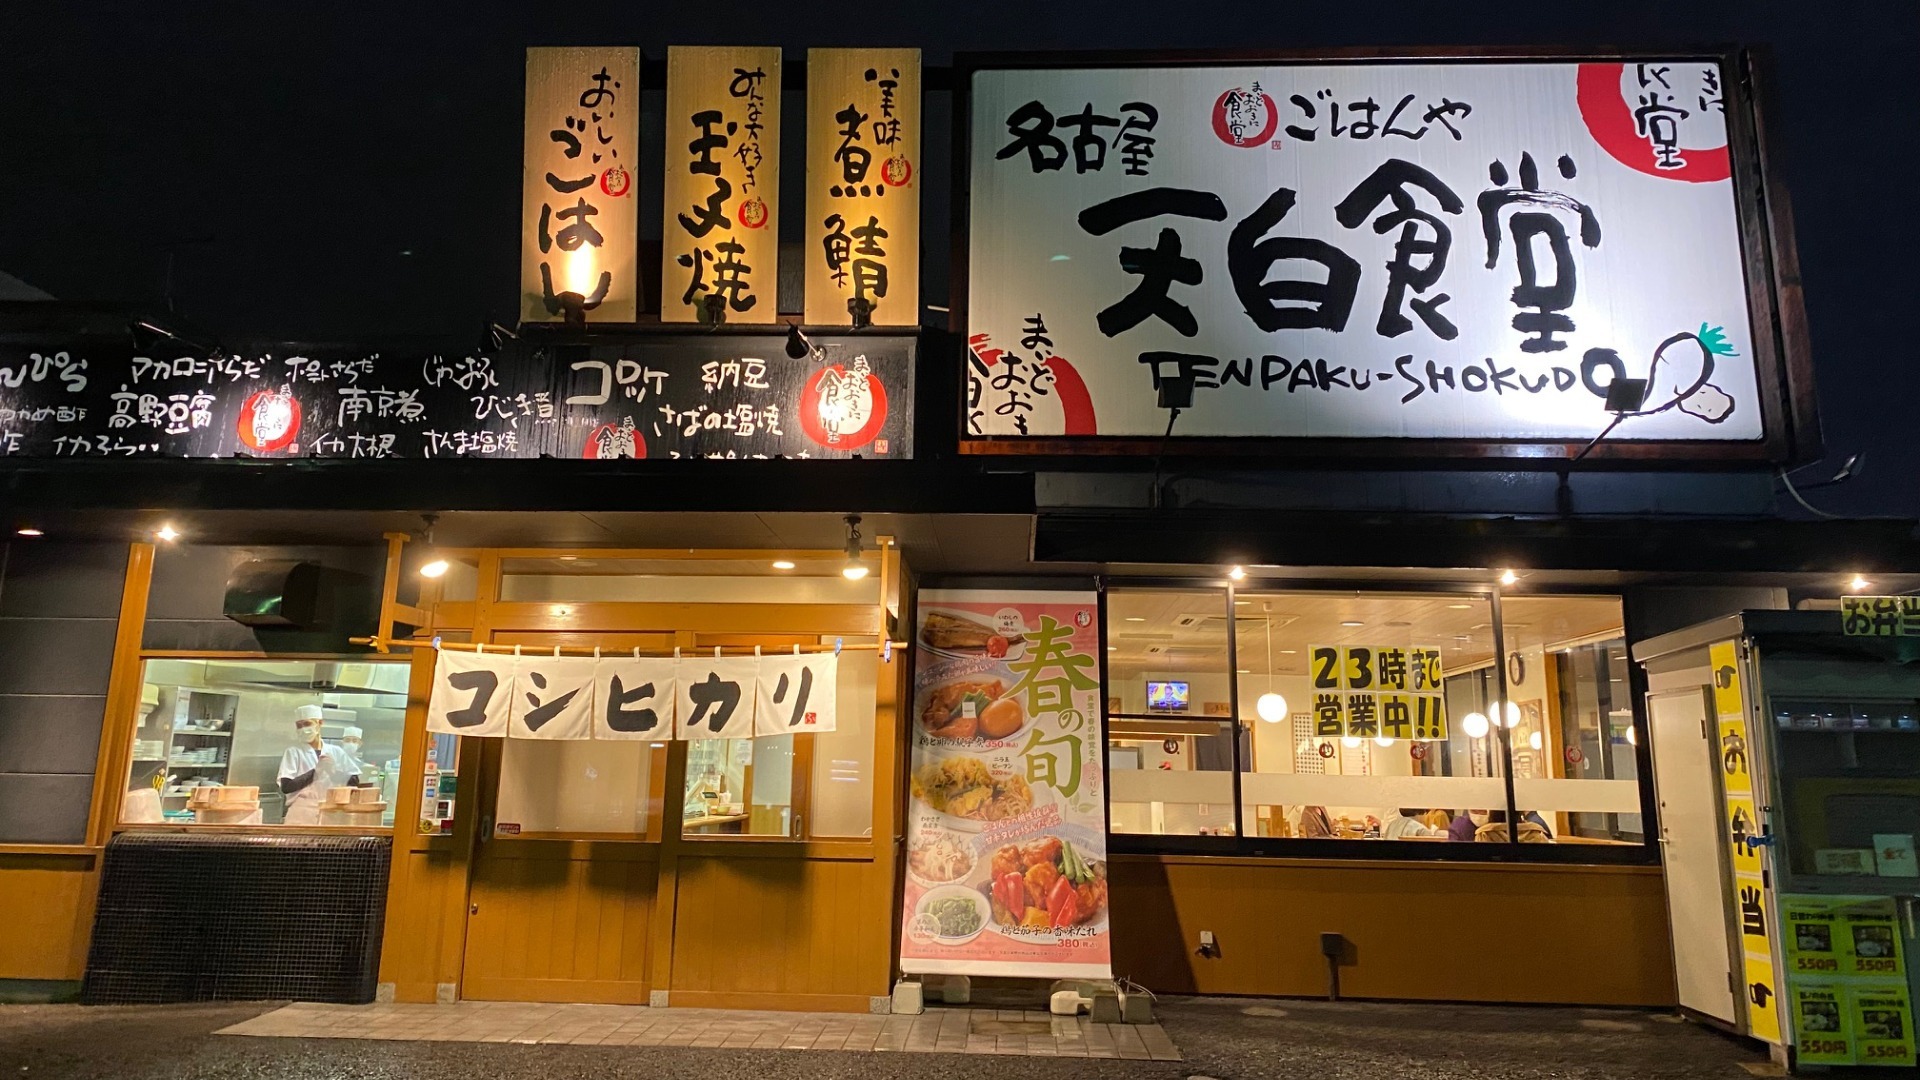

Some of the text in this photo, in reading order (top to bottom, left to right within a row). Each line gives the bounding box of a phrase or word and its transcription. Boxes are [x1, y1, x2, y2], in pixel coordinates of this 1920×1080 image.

[580, 66, 621, 164] おいしい
[729, 66, 767, 194] みんな大好き
[864, 68, 903, 153] 美味
[1224, 91, 1247, 144] 食堂
[1283, 87, 1472, 143] ごはんや
[996, 100, 1159, 179] 名古屋
[677, 109, 758, 313] 玉子焼
[824, 103, 889, 299] 煮鯖
[1078, 150, 1602, 354] 天白食堂
[131, 353, 272, 384] マカロニさらだ
[701, 357, 770, 394] 納豆
[1020, 313, 1055, 396] まいど
[1138, 346, 1628, 404] TENPAKU-SHOKUDO
[337, 384, 427, 428] 南京煮
[565, 358, 670, 405] コロッケ
[108, 383, 217, 435] 高野豆腐
[653, 402, 784, 438] さばの塩焼
[308, 431, 397, 459] イカ大根
[422, 428, 520, 459] さんま塩焼
[594, 426, 616, 459] 食
[1313, 647, 1441, 691] 23時まで
[446, 666, 813, 733] コシヒカリ
[999, 615, 1101, 798] 春の旬
[1314, 694, 1442, 739] 営業中!!
[1723, 729, 1766, 937] お弁当
[1798, 958, 1839, 971] 550円
[1856, 959, 1897, 972] 550円
[1800, 1040, 1848, 1055] 550円
[1867, 1045, 1908, 1058] 550円
